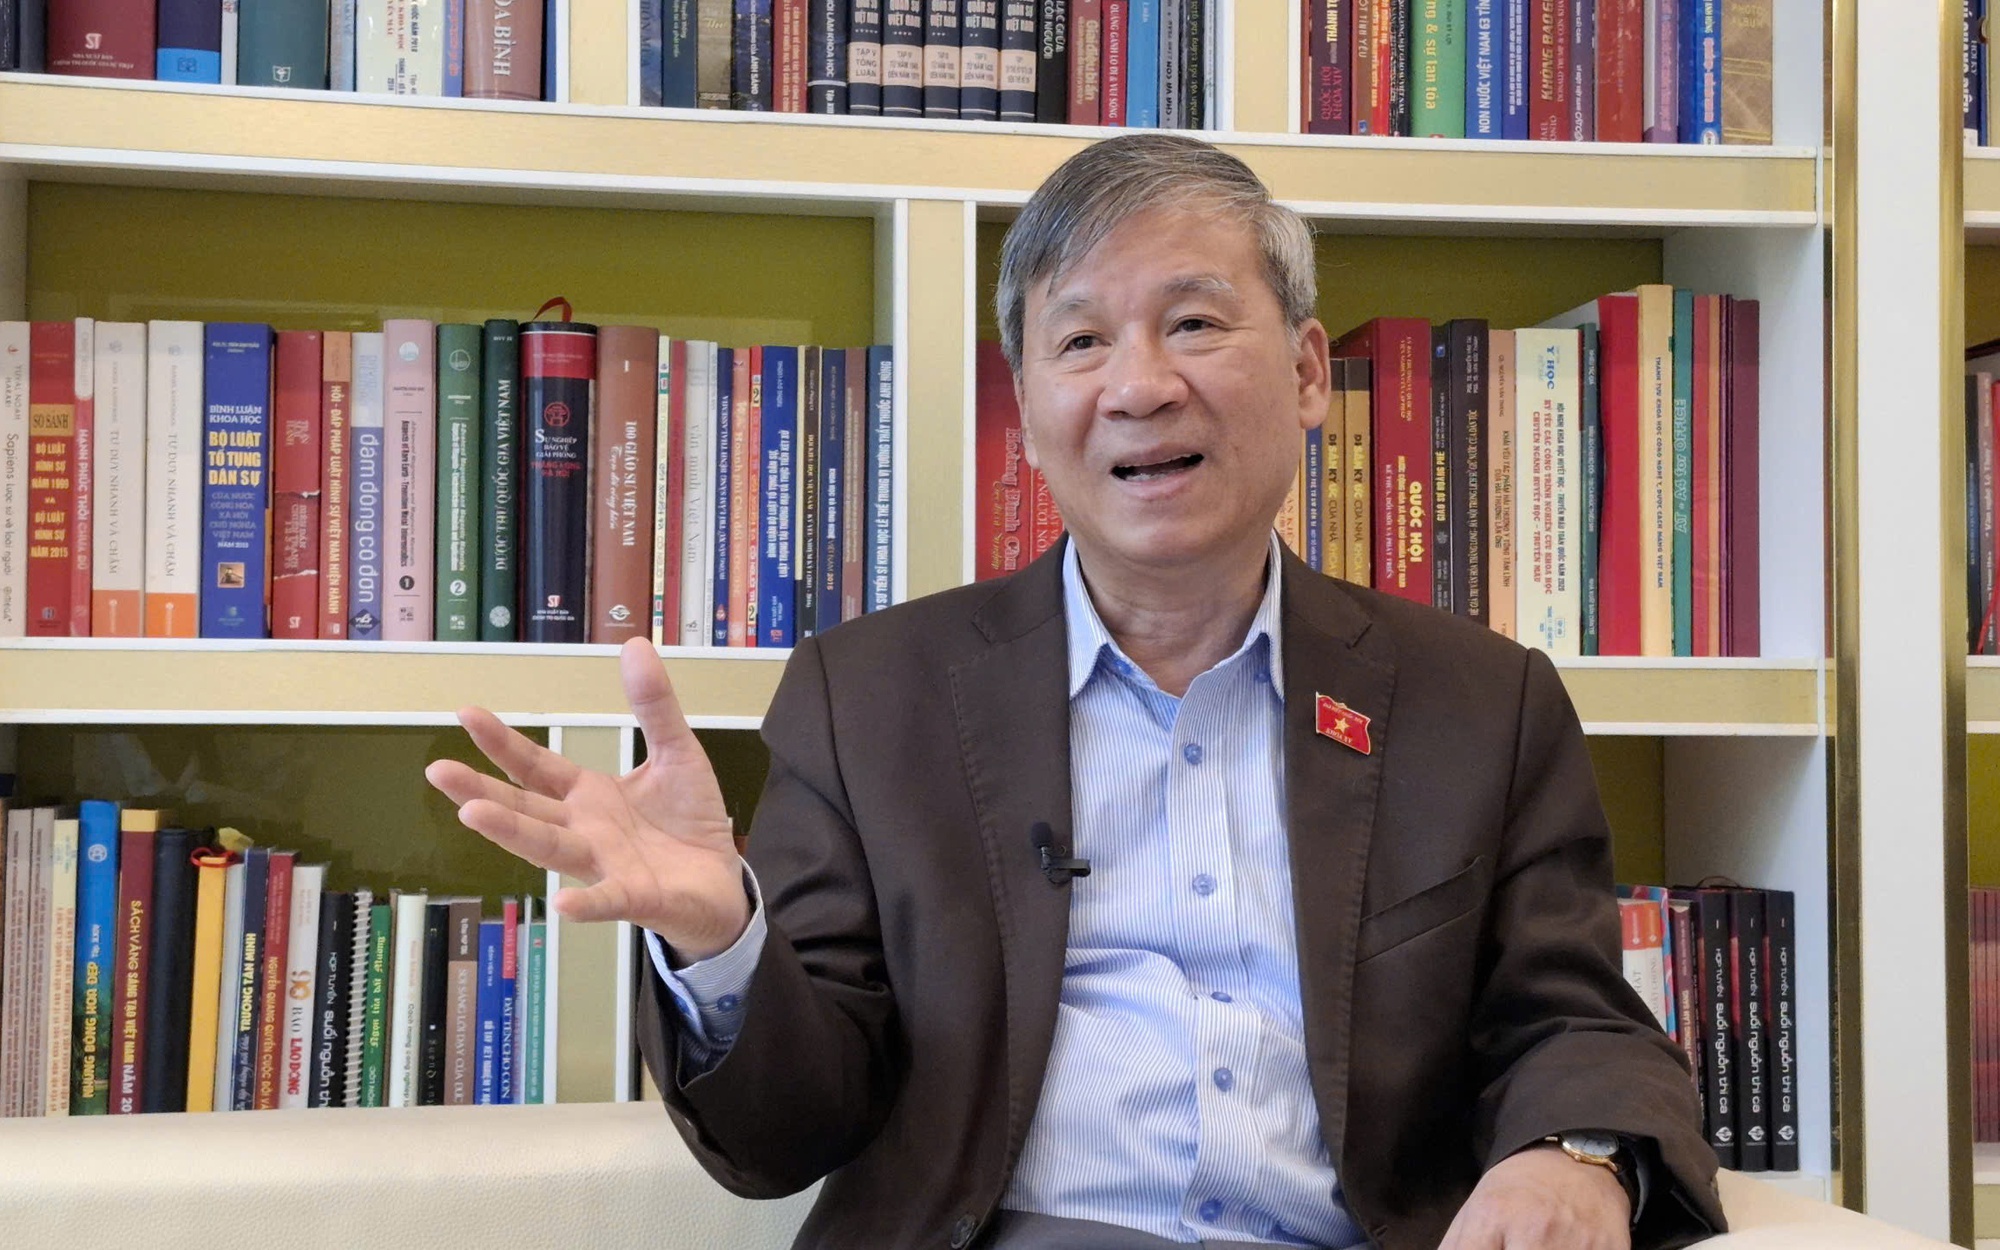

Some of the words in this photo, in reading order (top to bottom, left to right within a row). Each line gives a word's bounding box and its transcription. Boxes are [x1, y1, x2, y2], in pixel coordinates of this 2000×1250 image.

[498, 379, 511, 408] NAM
[1674, 399, 1686, 451] OFFICE
[5, 433, 19, 479] Sapiens
[1409, 481, 1426, 528] QUỐC
[622, 520, 634, 546] NAM
[1408, 532, 1424, 563] HỘI
[245, 933, 257, 961] MINH
[1715, 1002, 1728, 1030] suối
[1749, 1001, 1762, 1029] suối
[1780, 1001, 1793, 1029] suối
[290, 1038, 303, 1060] LAO
[501, 1072, 511, 1098] CON
[1718, 1077, 1728, 1094] thi
[1751, 1076, 1761, 1094] thi
[1782, 1076, 1791, 1093] thi
[1719, 1097, 1727, 1114] ca
[1752, 1096, 1760, 1113] ca
[1782, 1095, 1790, 1112] ca
